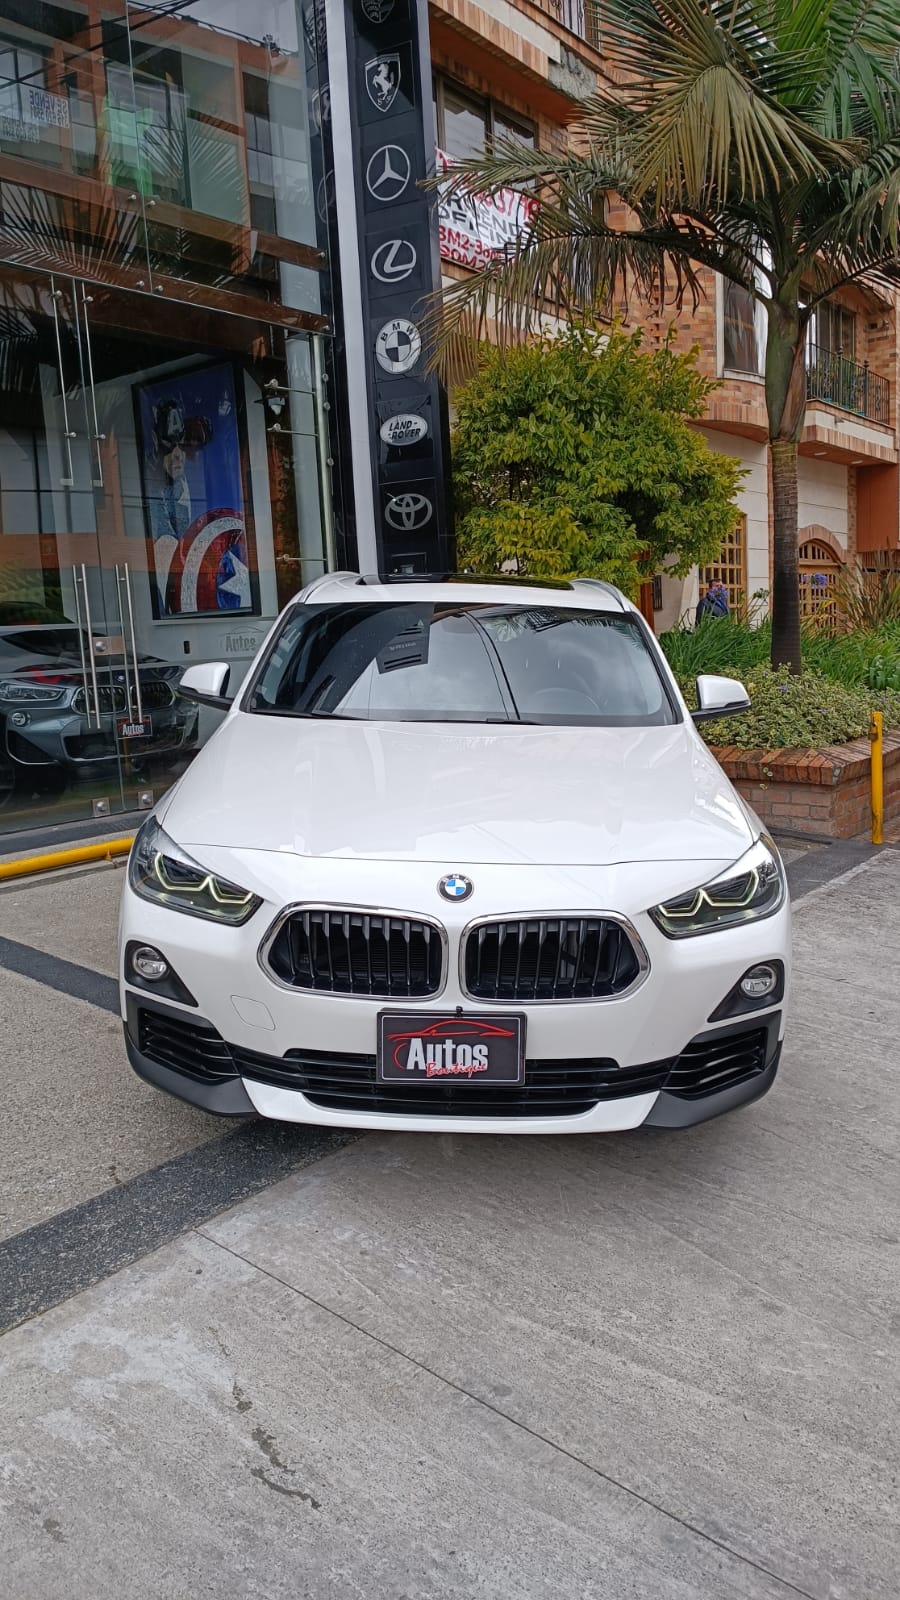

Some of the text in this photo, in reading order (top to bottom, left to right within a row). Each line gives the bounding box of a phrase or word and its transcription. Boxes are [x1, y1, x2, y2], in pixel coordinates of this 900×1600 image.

[225, 634, 256, 652] Autos
[122, 723, 145, 736] Autos
[406, 1037, 488, 1070] Autos
[426, 1062, 487, 1078] Boutique
